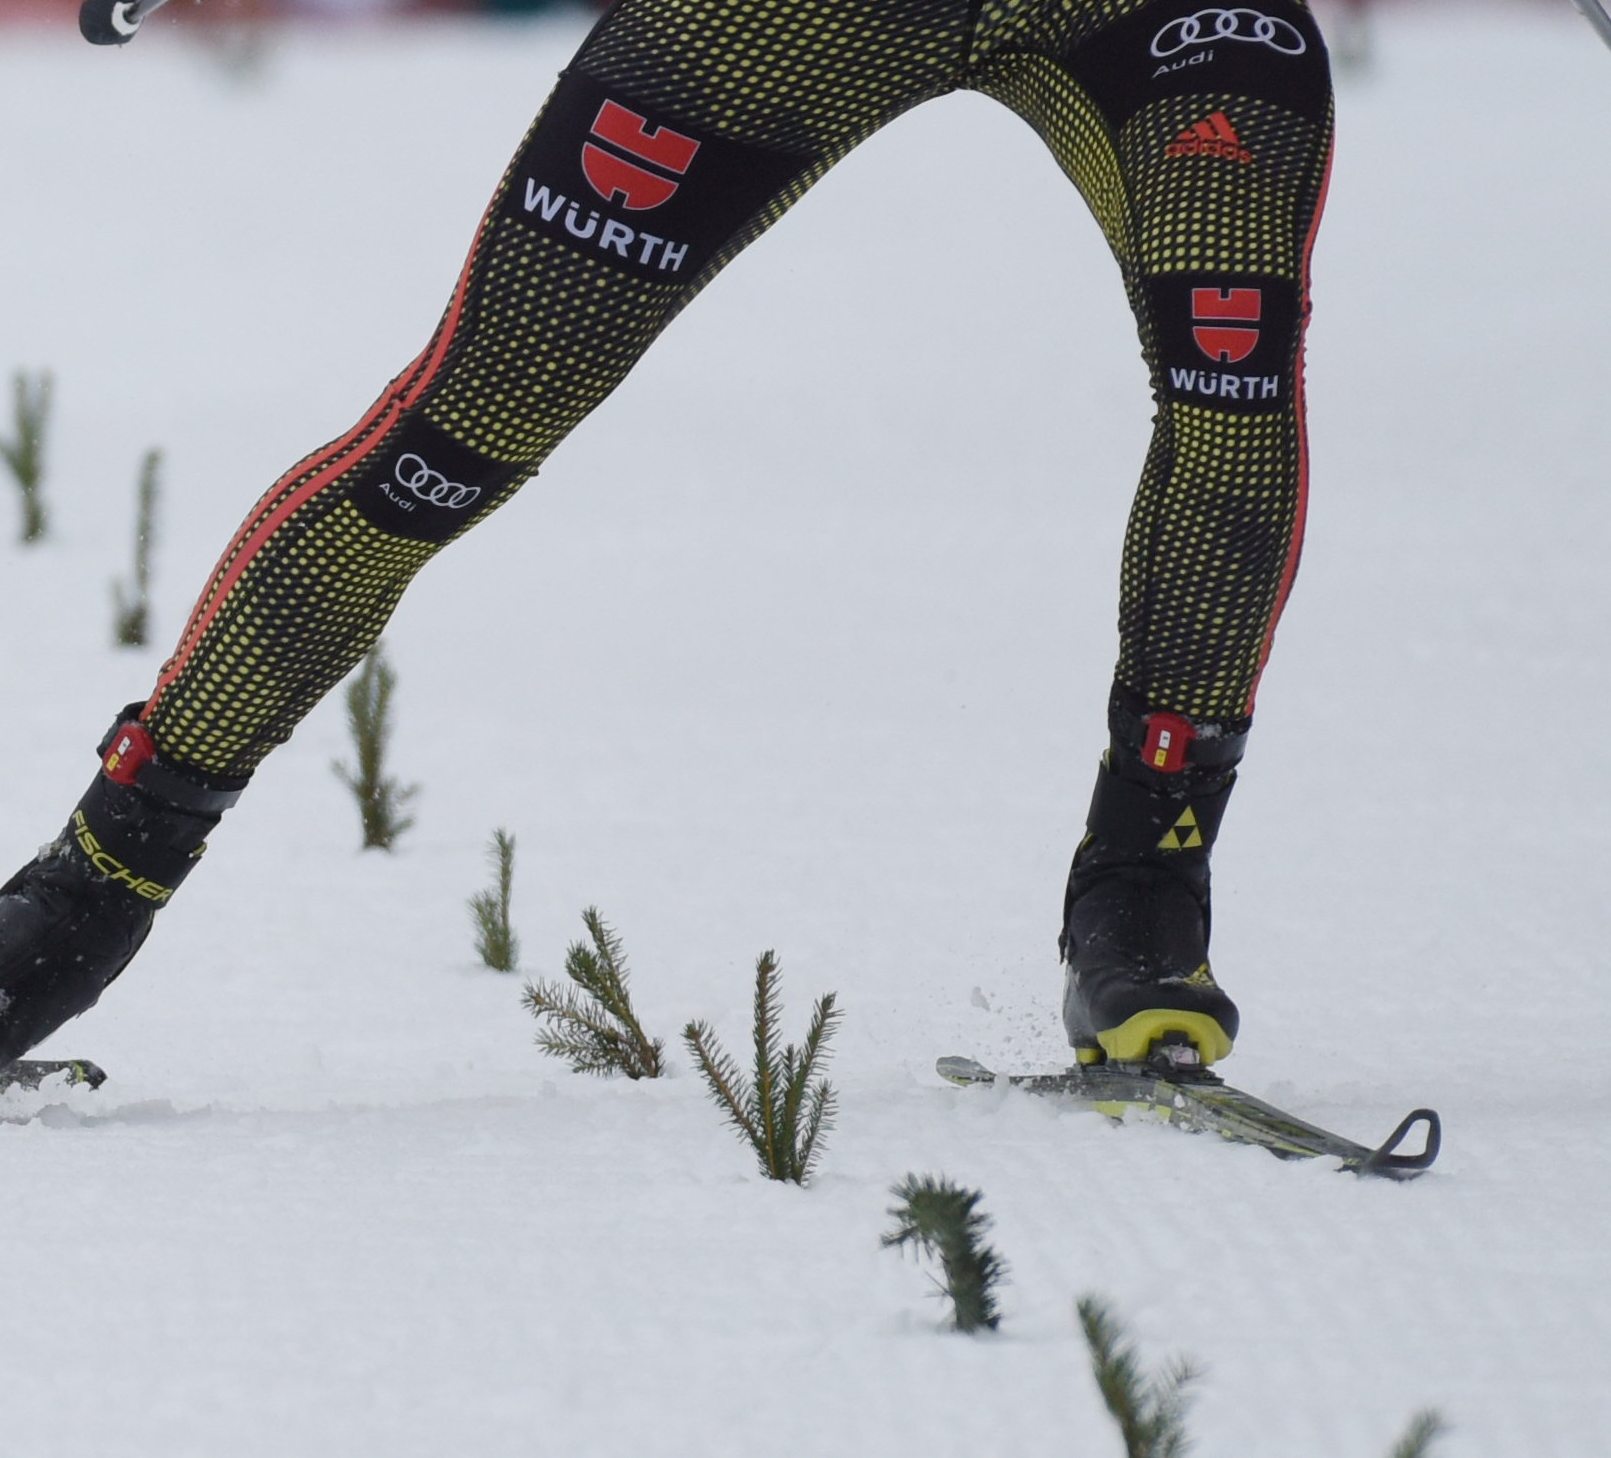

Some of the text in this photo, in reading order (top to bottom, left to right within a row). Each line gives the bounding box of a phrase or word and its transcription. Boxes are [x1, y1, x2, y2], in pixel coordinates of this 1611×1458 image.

[1151, 49, 1215, 80] Audi
[1165, 139, 1253, 164] adidas
[523, 177, 689, 272] WÜRTH
[1170, 366, 1279, 400] WÜRTH
[378, 482, 417, 512] Audi
[71, 809, 174, 903] FISCHER
